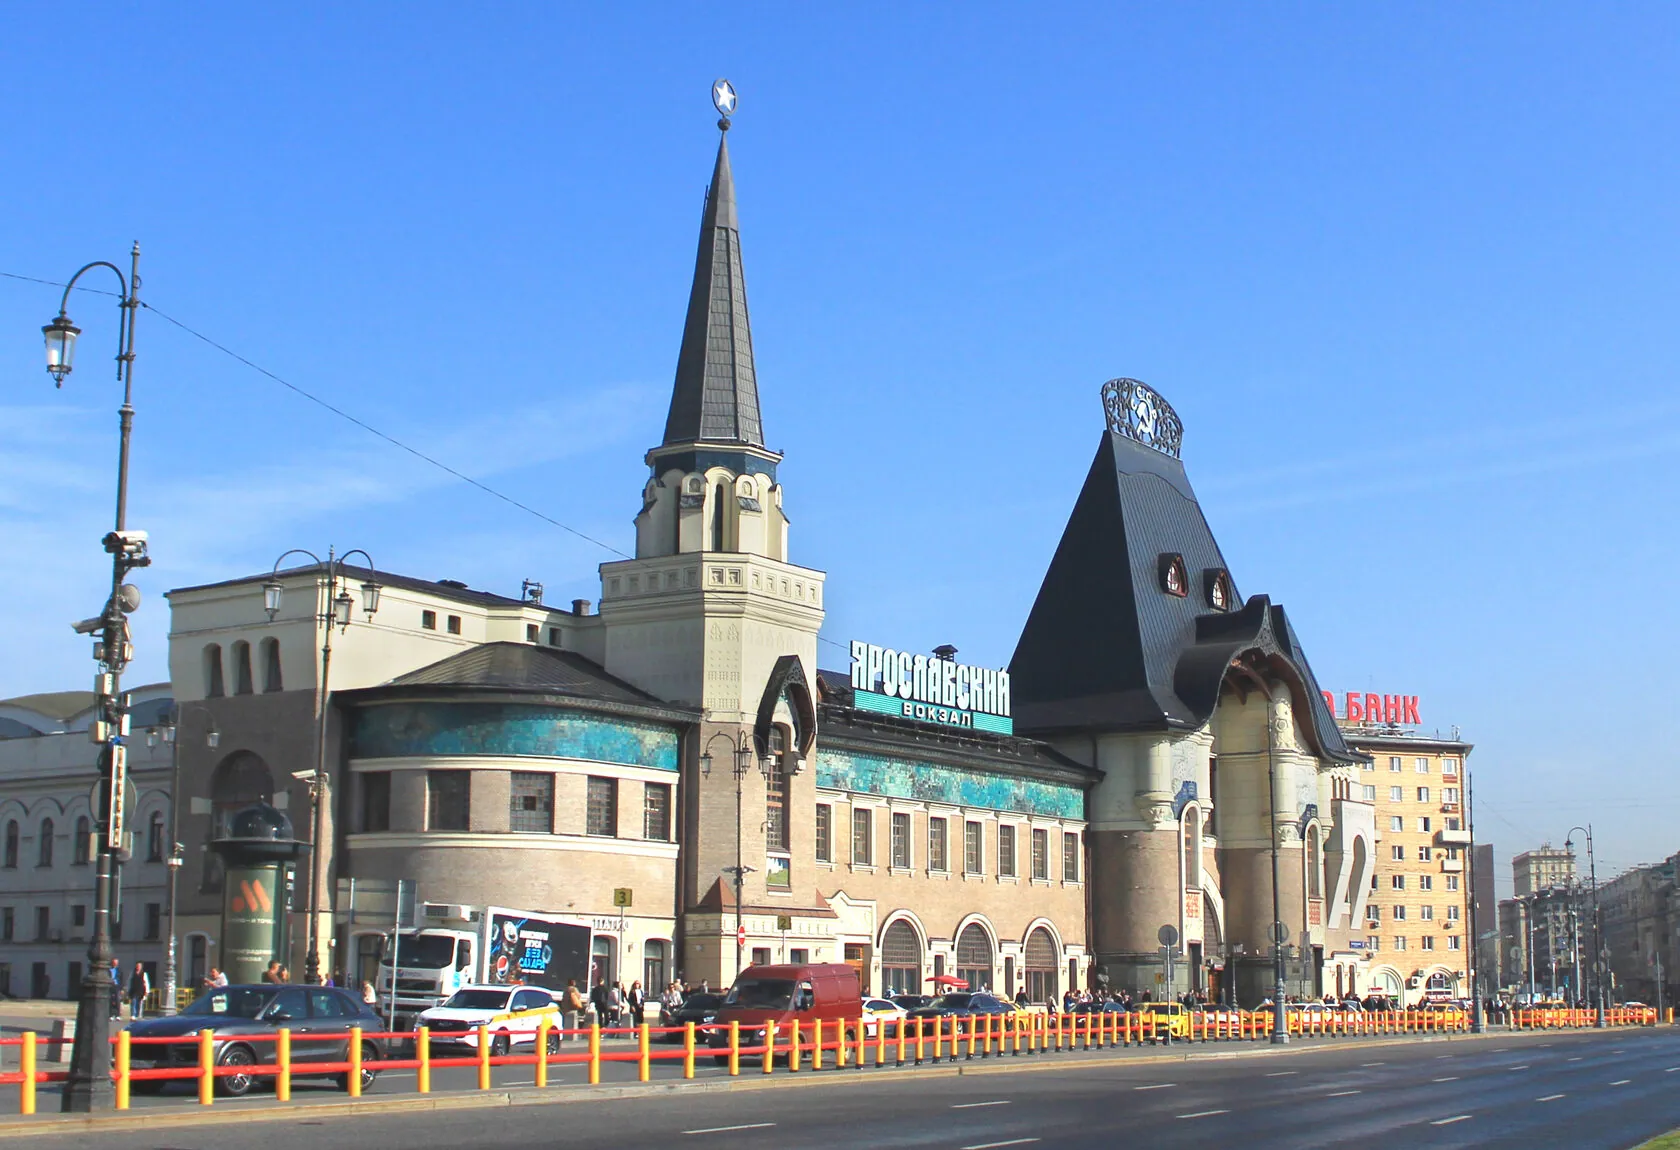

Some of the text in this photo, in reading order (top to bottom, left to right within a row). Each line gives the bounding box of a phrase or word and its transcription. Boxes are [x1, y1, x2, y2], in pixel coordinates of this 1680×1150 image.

[850, 640, 1010, 716] ЯРОСЛАВСКИЙ
[902, 702, 972, 727] ВОКЗАЛ
[1347, 692, 1422, 724] БАНК
[619, 892, 626, 904] 3
[780, 918, 786, 927] 2
